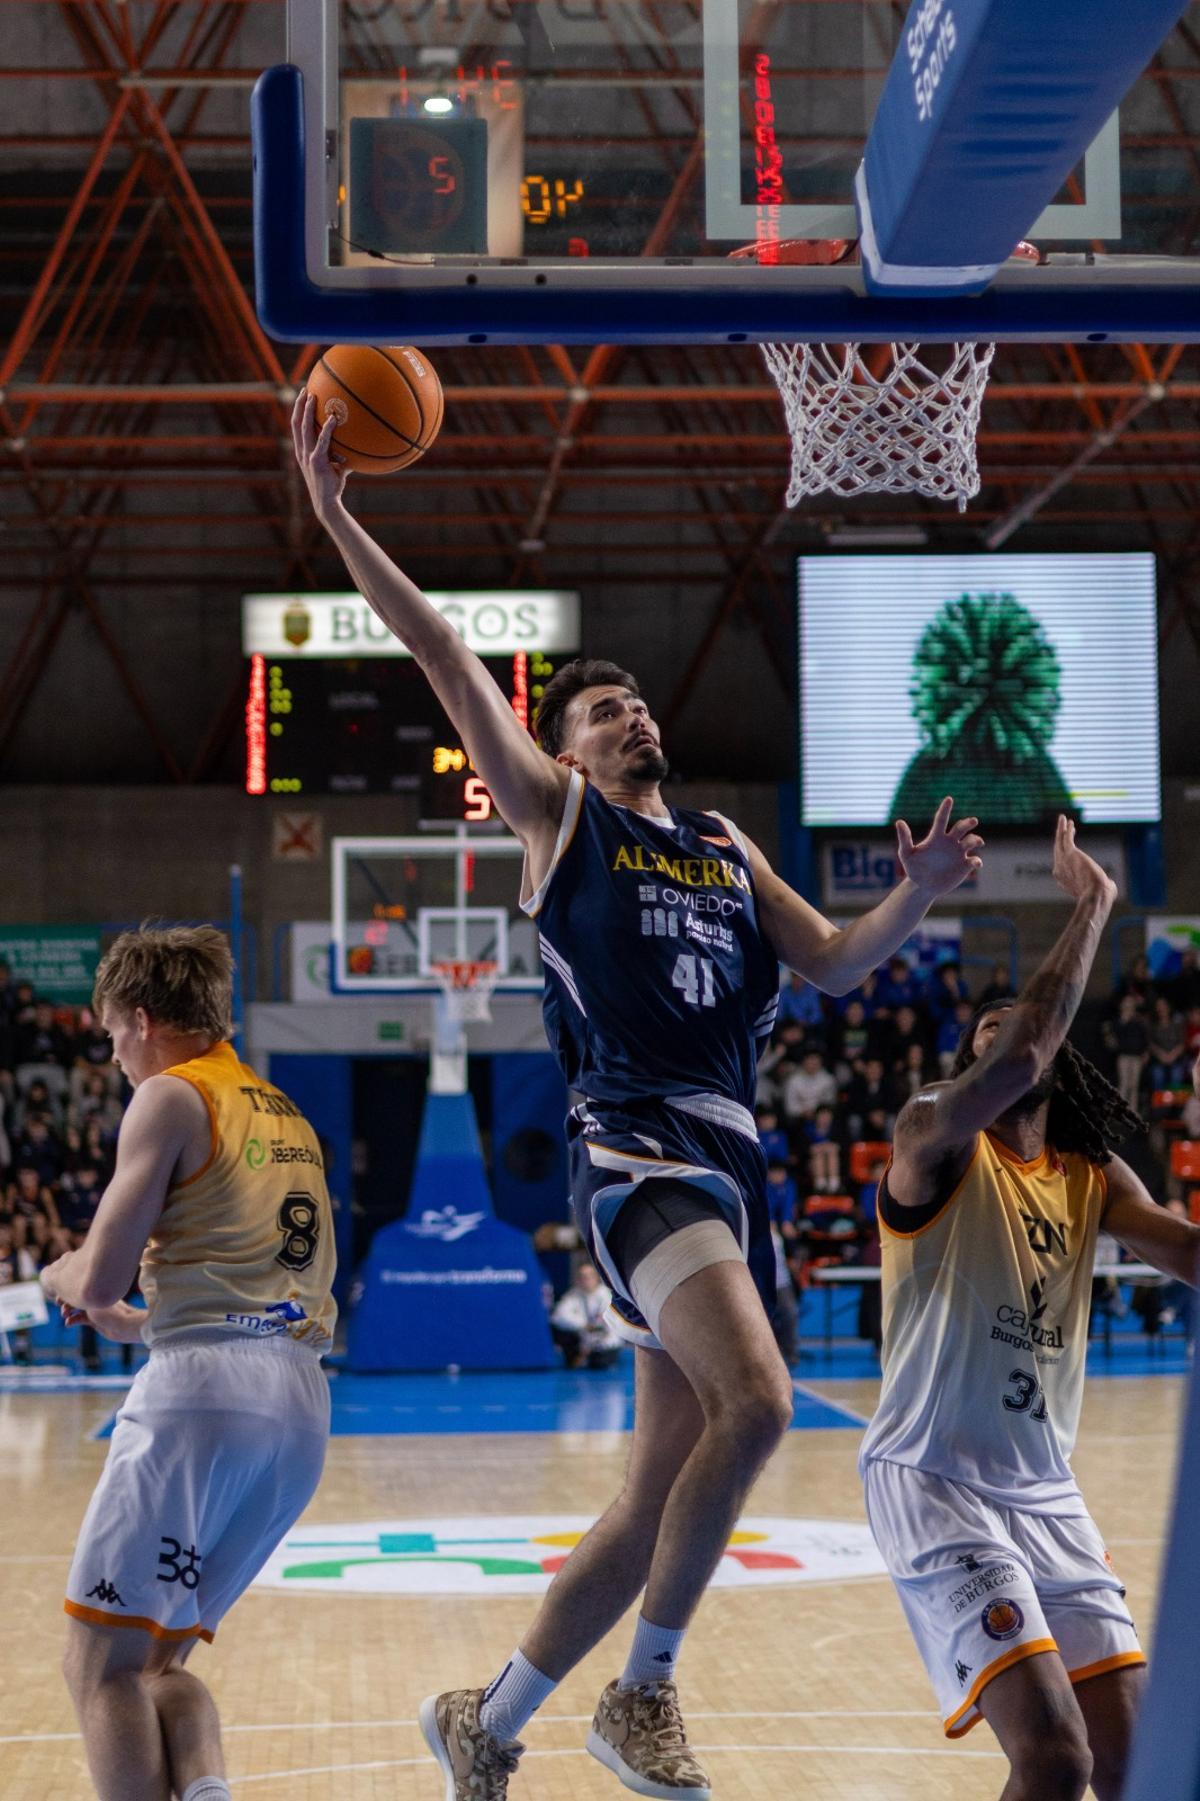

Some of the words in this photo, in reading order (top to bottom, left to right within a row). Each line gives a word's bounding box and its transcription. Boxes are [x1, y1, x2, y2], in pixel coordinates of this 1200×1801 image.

[331, 604, 539, 642] BUGOS
[464, 778, 490, 820] 5
[831, 846, 898, 887] Big
[662, 888, 736, 916] OVIEDO
[672, 953, 717, 1008] 41
[274, 1191, 320, 1272] 8
[953, 1599, 968, 1614] DE
[965, 1571, 1020, 1604] BURGOS
